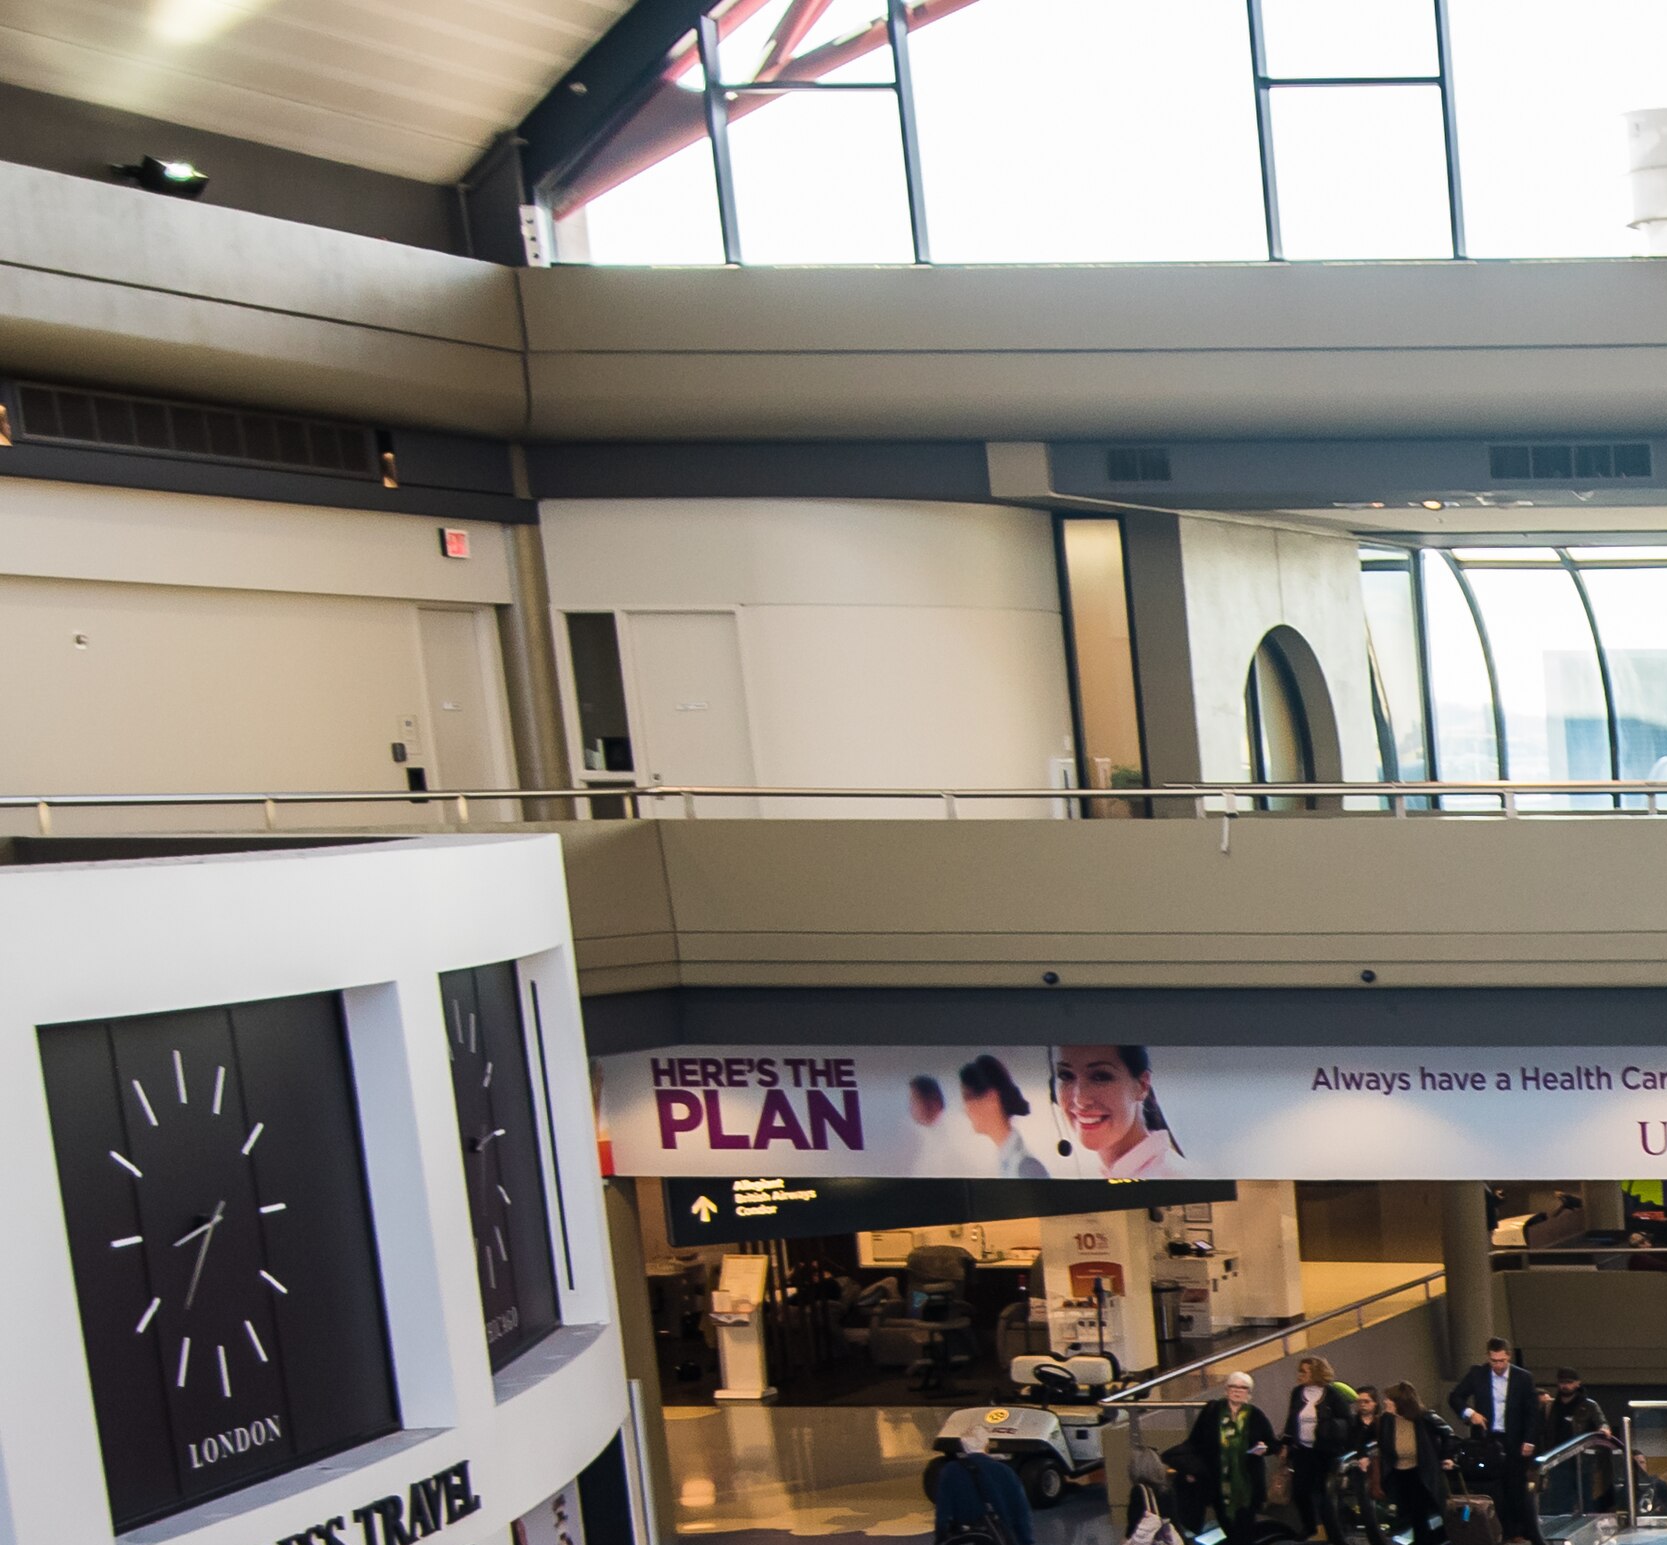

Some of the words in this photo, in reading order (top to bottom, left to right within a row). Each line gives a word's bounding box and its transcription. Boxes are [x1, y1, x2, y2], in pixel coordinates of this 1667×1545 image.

[651, 1057, 780, 1088] HERE'S
[784, 1057, 858, 1088] THE
[1311, 1065, 1411, 1095] Always
[1420, 1066, 1486, 1091] have
[1495, 1070, 1512, 1091] a
[1521, 1065, 1612, 1091] Health
[655, 1088, 865, 1151] PLAN
[189, 1415, 282, 1469] LONDON
